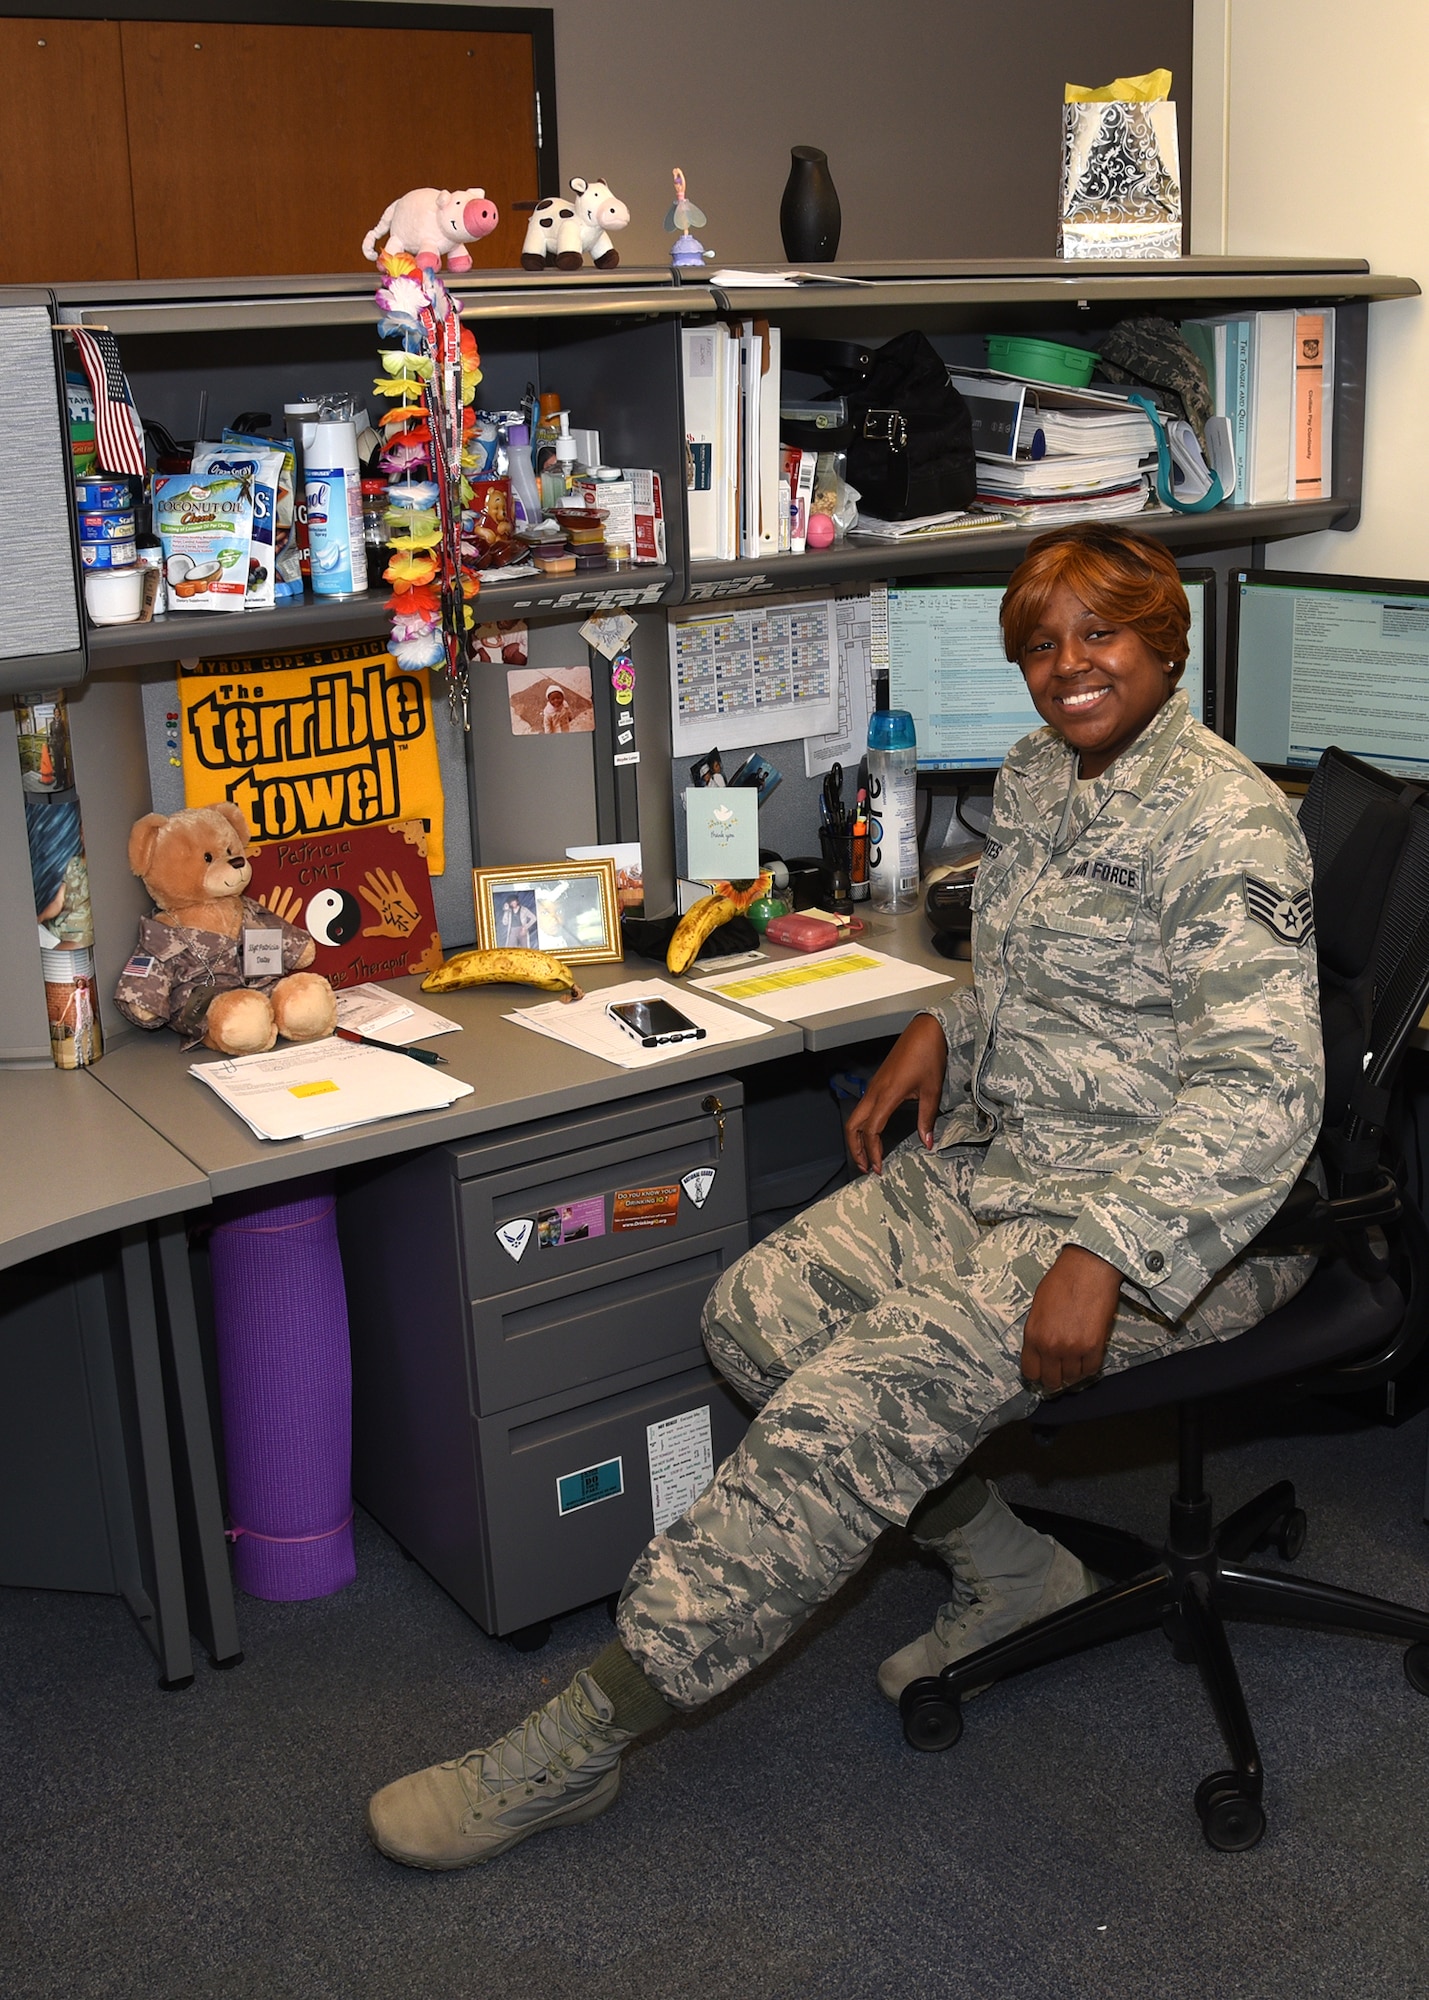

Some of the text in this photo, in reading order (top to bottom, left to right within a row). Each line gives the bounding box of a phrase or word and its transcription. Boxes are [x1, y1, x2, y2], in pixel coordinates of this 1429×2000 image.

[1240, 340, 1249, 355] THE
[1239, 358, 1248, 389] TONGUE
[1237, 408, 1247, 434] QUILL
[1305, 390, 1315, 460] Civilian Pay Continuity
[158, 500, 220, 513] COCONUT
[222, 501, 244, 513] OIL
[181, 511, 217, 525] Chews
[193, 660, 252, 675] MYRON
[263, 654, 323, 670] COPE'S
[219, 684, 264, 700] The
[187, 664, 427, 770] terrible
[225, 740, 401, 842] towel
[725, 833, 735, 842] you
[277, 840, 352, 869] Patricia
[299, 861, 346, 886] CMT
[1092, 861, 1136, 888] FORCE
[683, 1171, 700, 1184] NATIONAL
[625, 1198, 656, 1207] DRINKING
